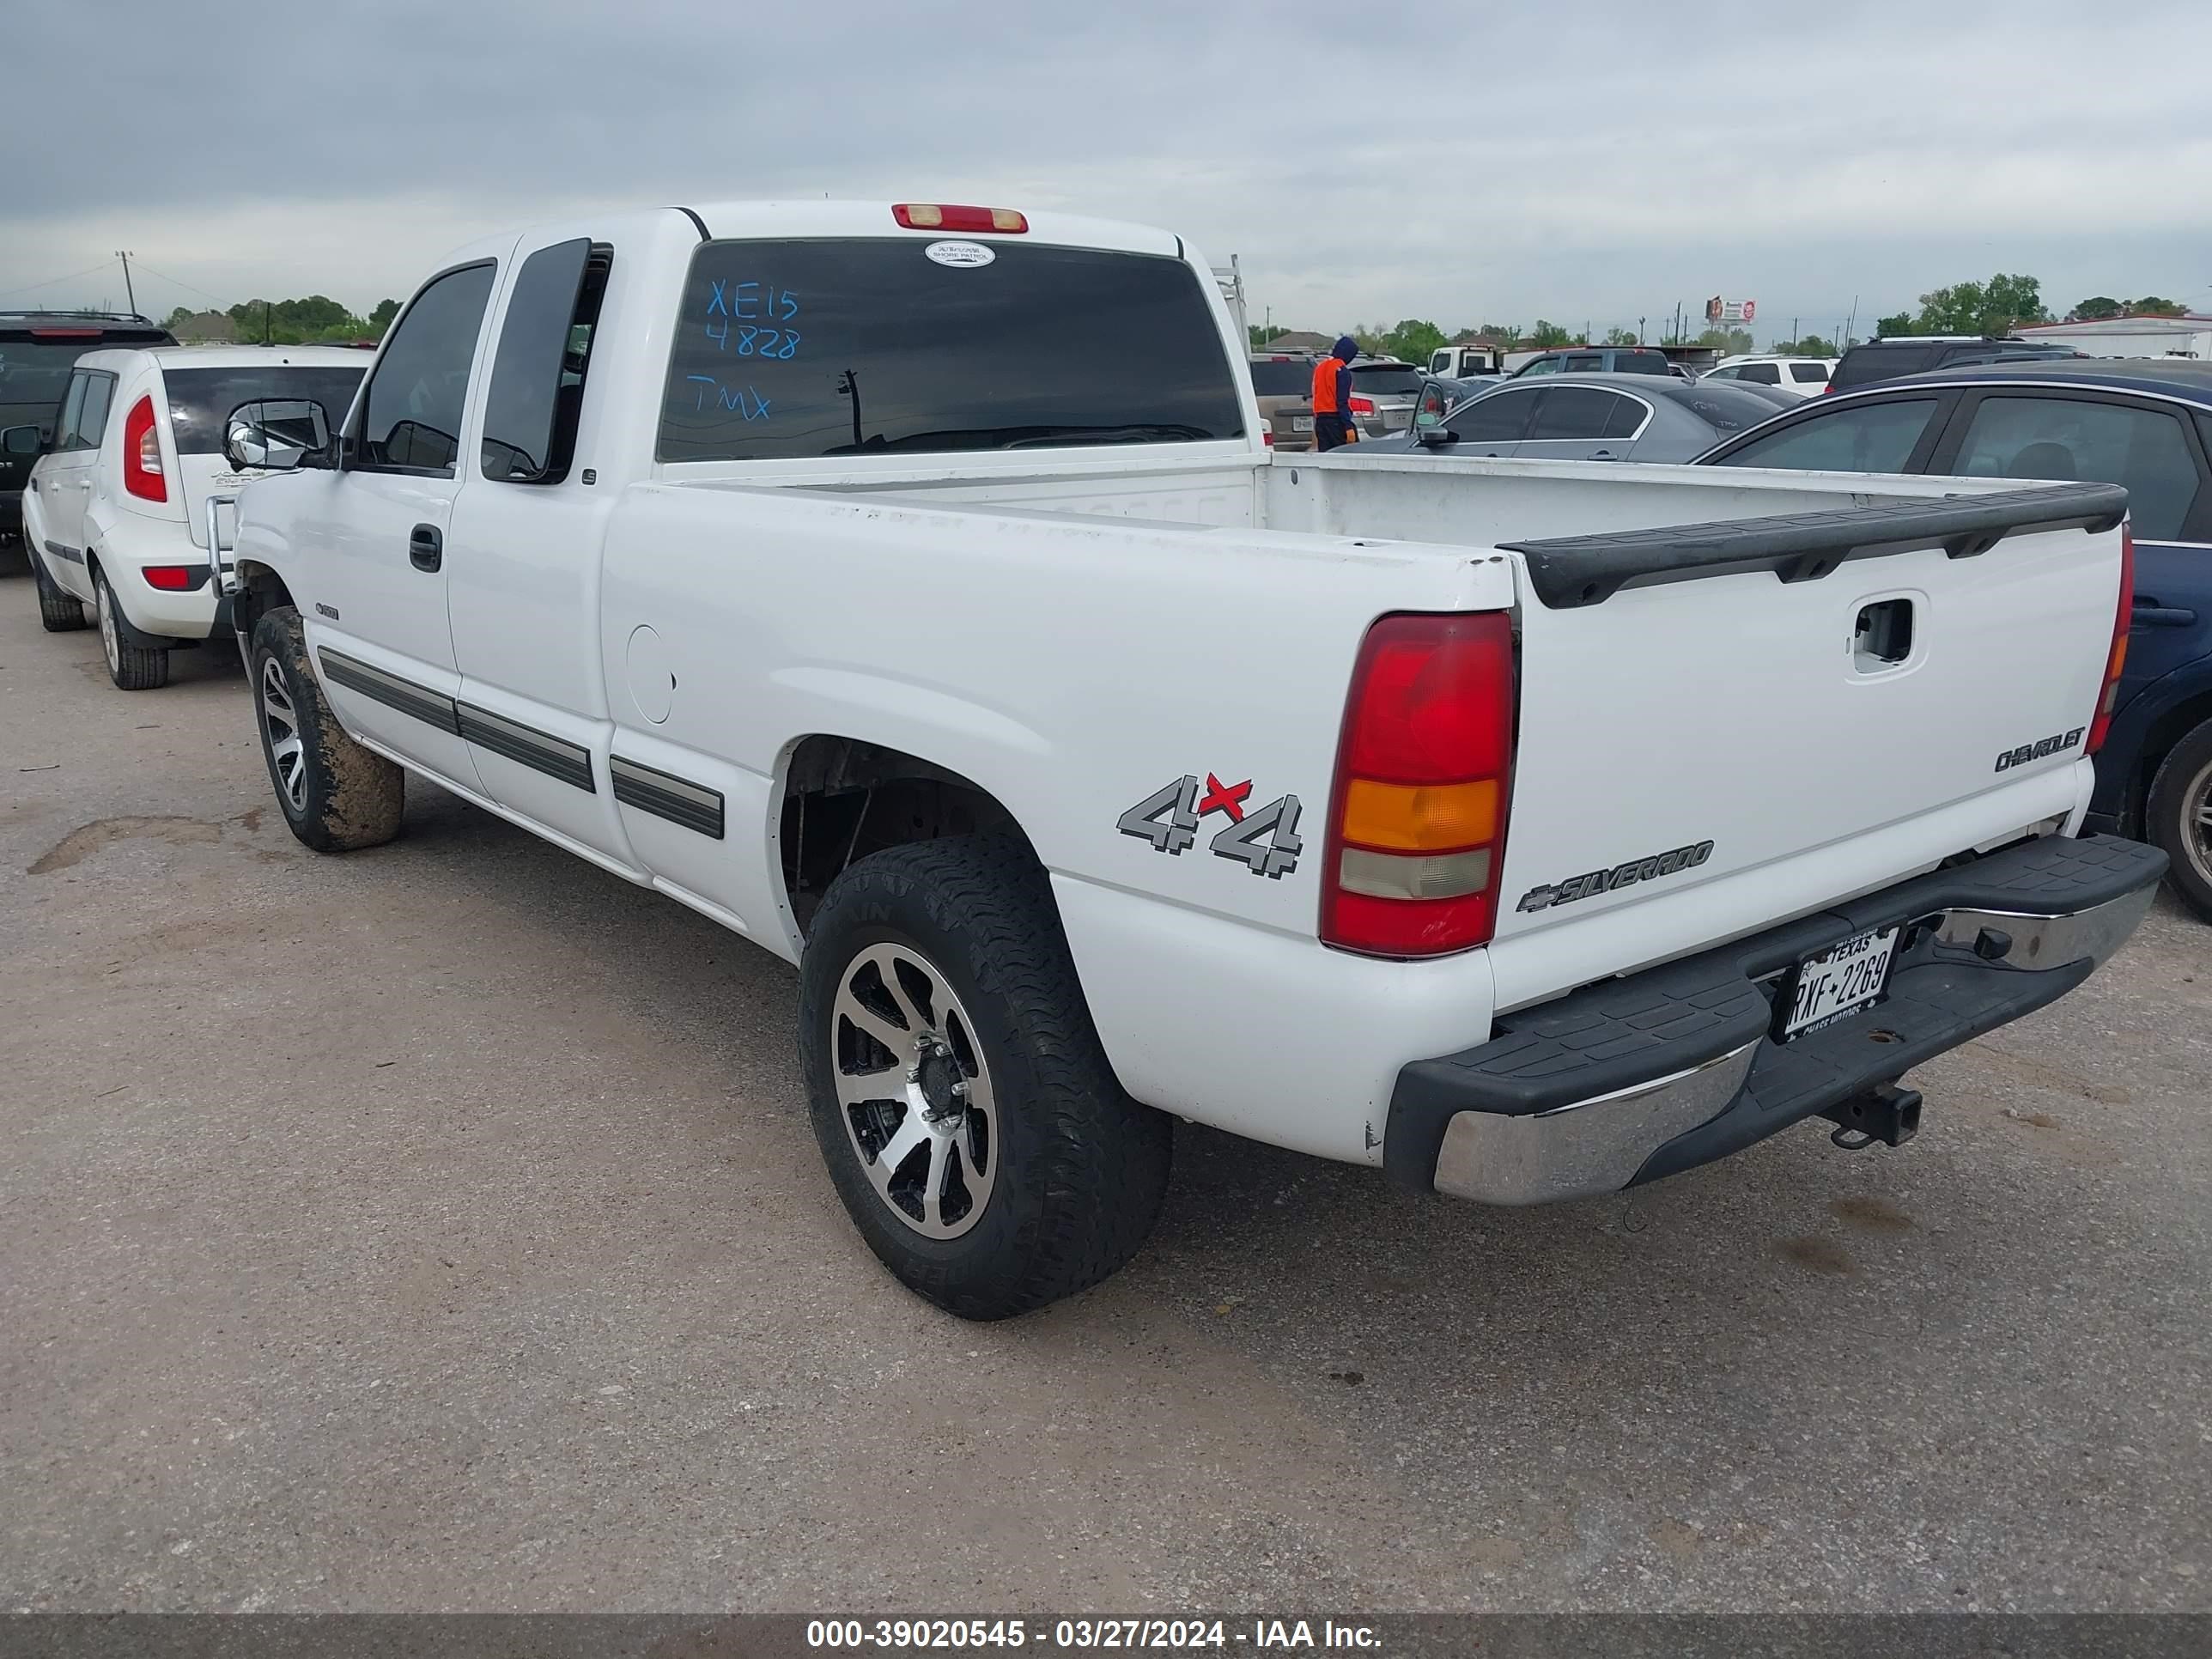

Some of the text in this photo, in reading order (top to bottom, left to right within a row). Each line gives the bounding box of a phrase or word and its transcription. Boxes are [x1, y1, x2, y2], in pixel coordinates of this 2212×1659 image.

[706, 319, 802, 360] 4828
[687, 374, 771, 421] TMX
[1994, 726, 2087, 773] CHEVROLET
[1555, 839, 1716, 905] SILVERADO
[1830, 938, 1871, 965] TEXAS
